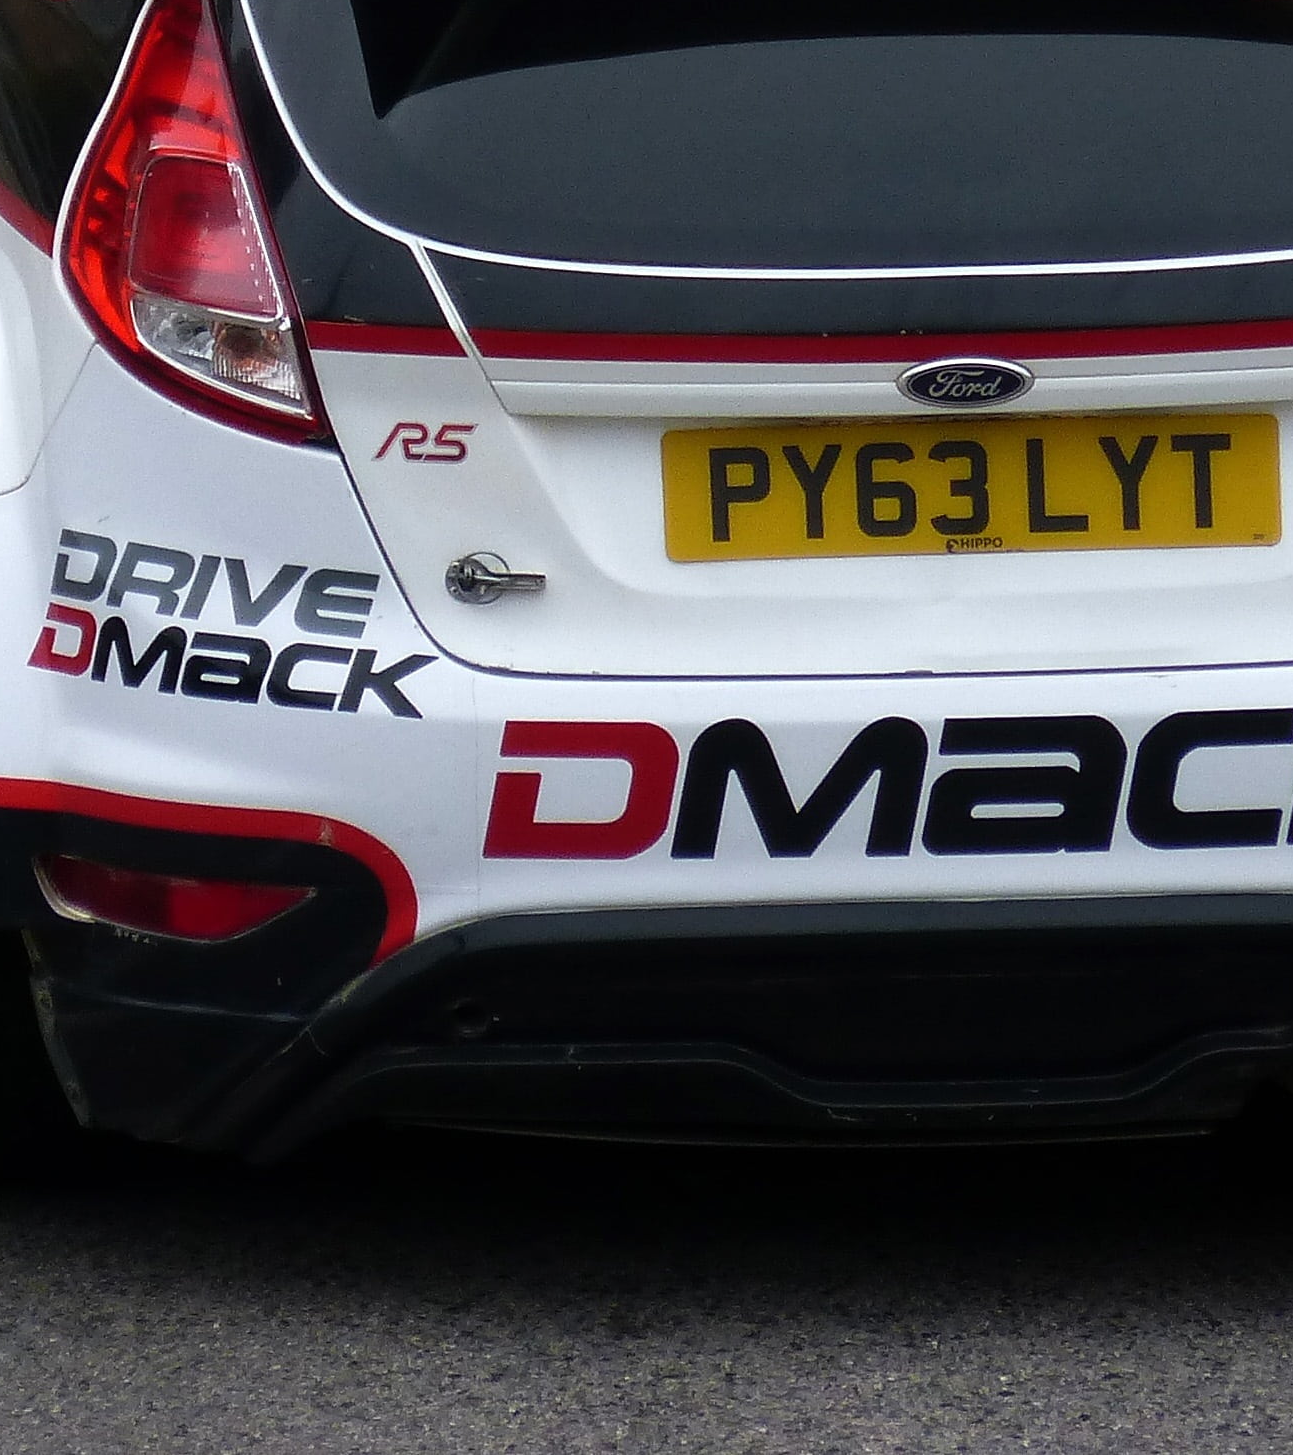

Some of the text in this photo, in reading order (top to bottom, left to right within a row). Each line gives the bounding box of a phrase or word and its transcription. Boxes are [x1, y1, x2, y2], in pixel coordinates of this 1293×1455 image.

[927, 369, 1006, 399] Ford
[373, 422, 479, 464] RS
[708, 432, 1232, 542] PY63 LYT
[960, 536, 1004, 549] HIPPO
[52, 527, 382, 639] DRIVE
